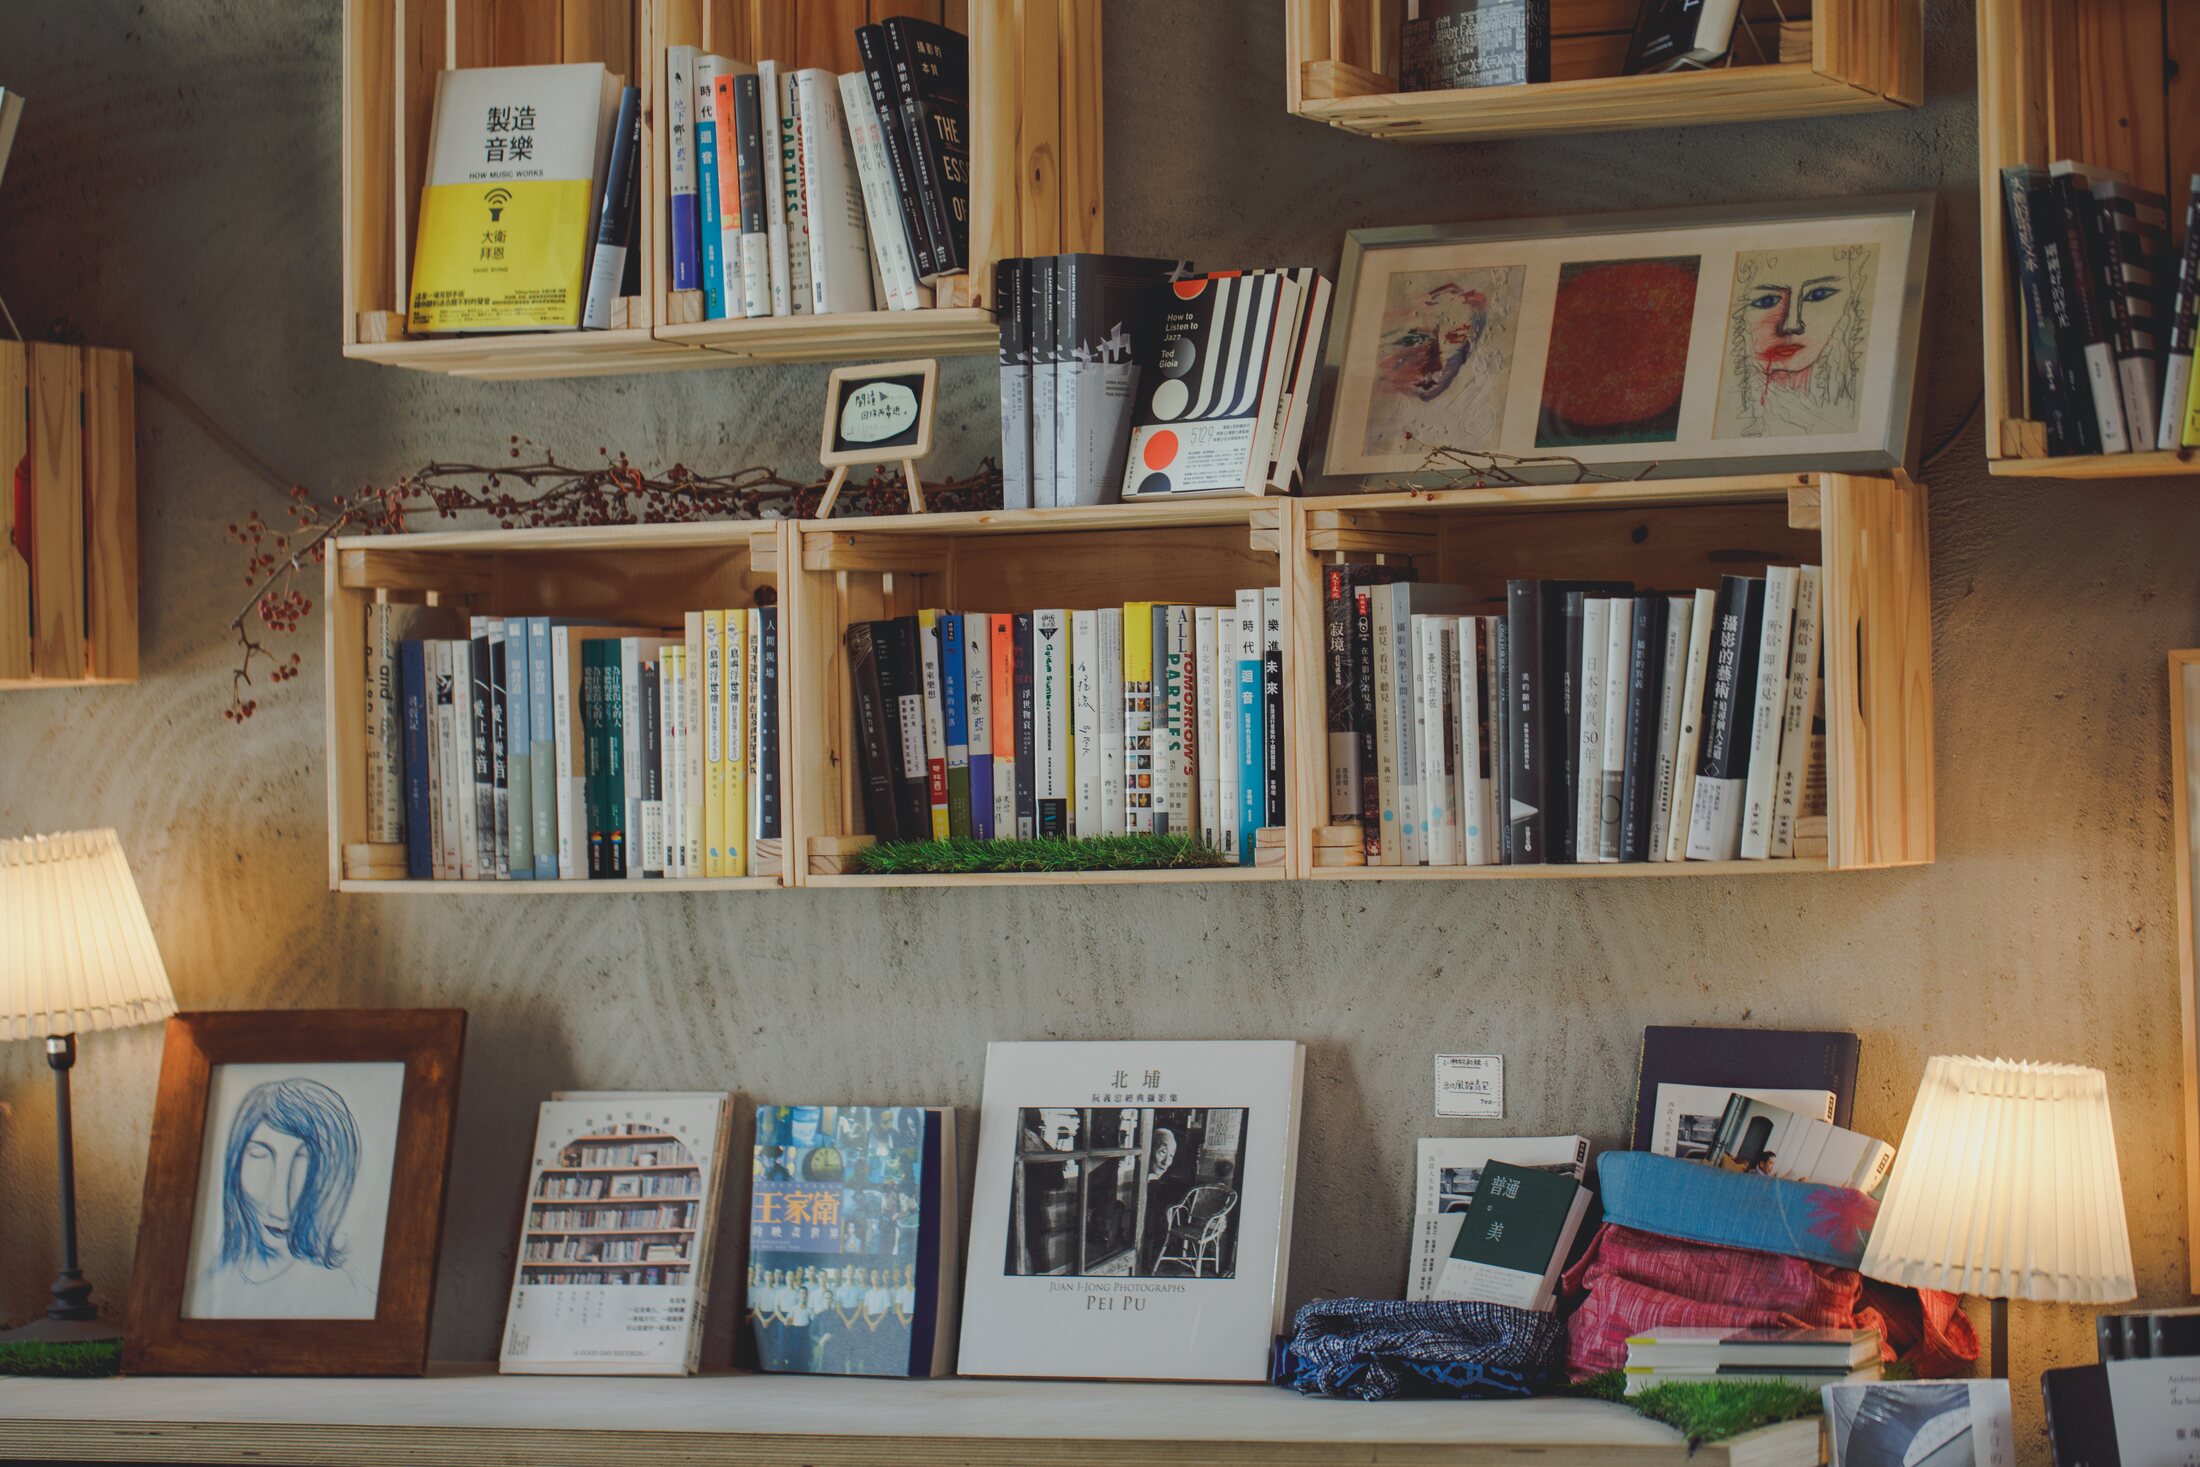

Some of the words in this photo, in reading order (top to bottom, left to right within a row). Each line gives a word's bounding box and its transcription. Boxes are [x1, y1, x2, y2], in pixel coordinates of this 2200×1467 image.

[916, 40, 943, 58] 攝影的
[921, 62, 939, 77] 本質
[486, 105, 537, 133] 製造
[934, 113, 961, 144] THE
[484, 135, 534, 163] 音樂
[469, 172, 487, 180] HOW
[489, 171, 514, 179] MUSIC
[515, 169, 544, 178] WORKS
[783, 119, 799, 213] PARTIES
[952, 197, 967, 222] OF
[481, 230, 507, 244] 大衛
[480, 246, 505, 260] 拜恩
[1165, 323, 1189, 332] Listen
[1190, 321, 1198, 330] to
[1167, 313, 1184, 321] How
[1185, 312, 1194, 321] to
[1164, 333, 1181, 342] Jazz
[1159, 360, 1178, 368] Gioia
[1161, 350, 1175, 358] Ted
[1177, 607, 1188, 653] ALL
[1329, 622, 1345, 652] 寂境
[766, 619, 776, 679] 人間現場
[1266, 619, 1279, 695] 樂進未來
[1397, 622, 1409, 696] 攝影美學七問
[1241, 620, 1255, 704] 時代迴音
[1427, 652, 1438, 709] 臺北不存在
[1022, 689, 1032, 730] 浮世物哀
[1168, 653, 1181, 751] PARTIES
[1183, 652, 1194, 776] TOMORROW'S
[1111, 1070, 1161, 1089] 北埔
[1092, 1093, 1178, 1103] 阮義忠經典攝影集
[1489, 1175, 1521, 1200] 普通
[752, 1190, 840, 1226] 王家衛
[752, 1226, 840, 1240] 的映畫世界
[1050, 1281, 1074, 1292] JUAN
[1077, 1282, 1110, 1293] I-JONG
[1113, 1282, 1187, 1294] PHOTOGRAPHS
[1086, 1295, 1113, 1311] PEI
[1122, 1295, 1146, 1311] PU
